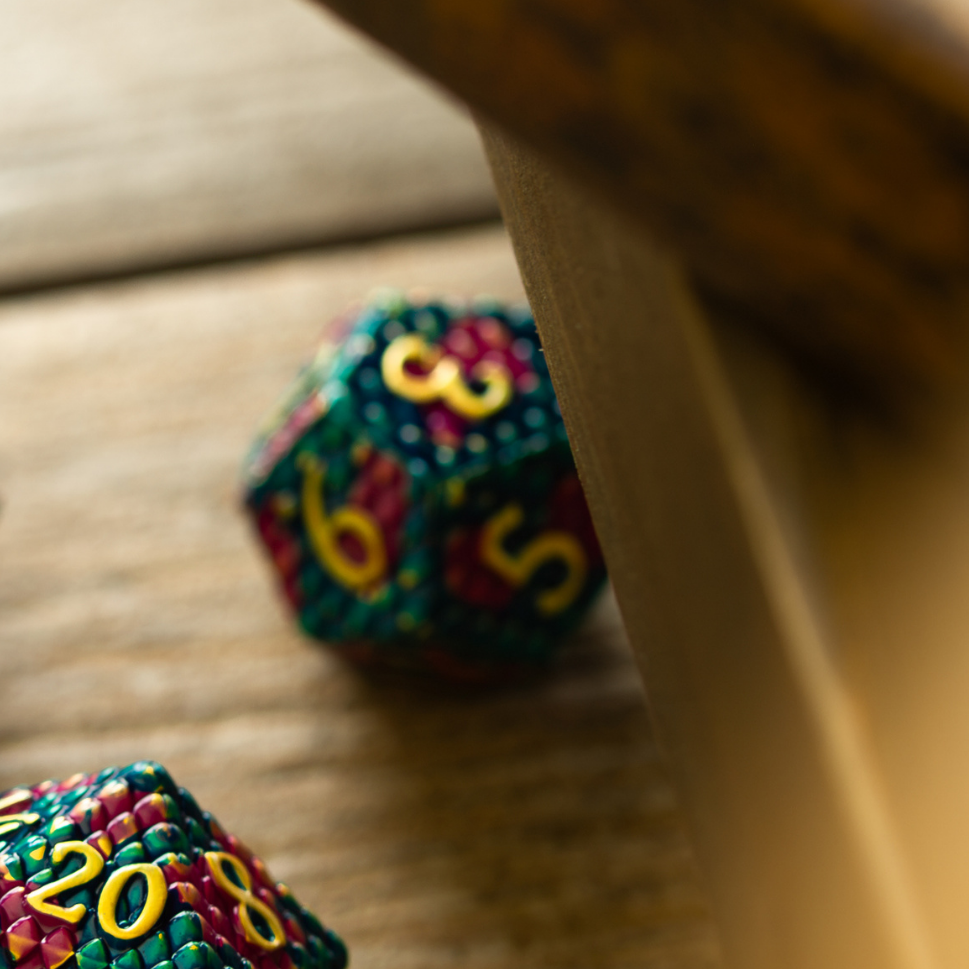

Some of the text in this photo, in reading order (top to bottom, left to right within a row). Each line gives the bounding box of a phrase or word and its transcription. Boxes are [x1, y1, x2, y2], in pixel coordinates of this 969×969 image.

[381, 333, 513, 419] 3
[299, 455, 387, 594] 6
[480, 504, 586, 617] 5
[27, 840, 168, 940] 20
[204, 851, 286, 949] 8
